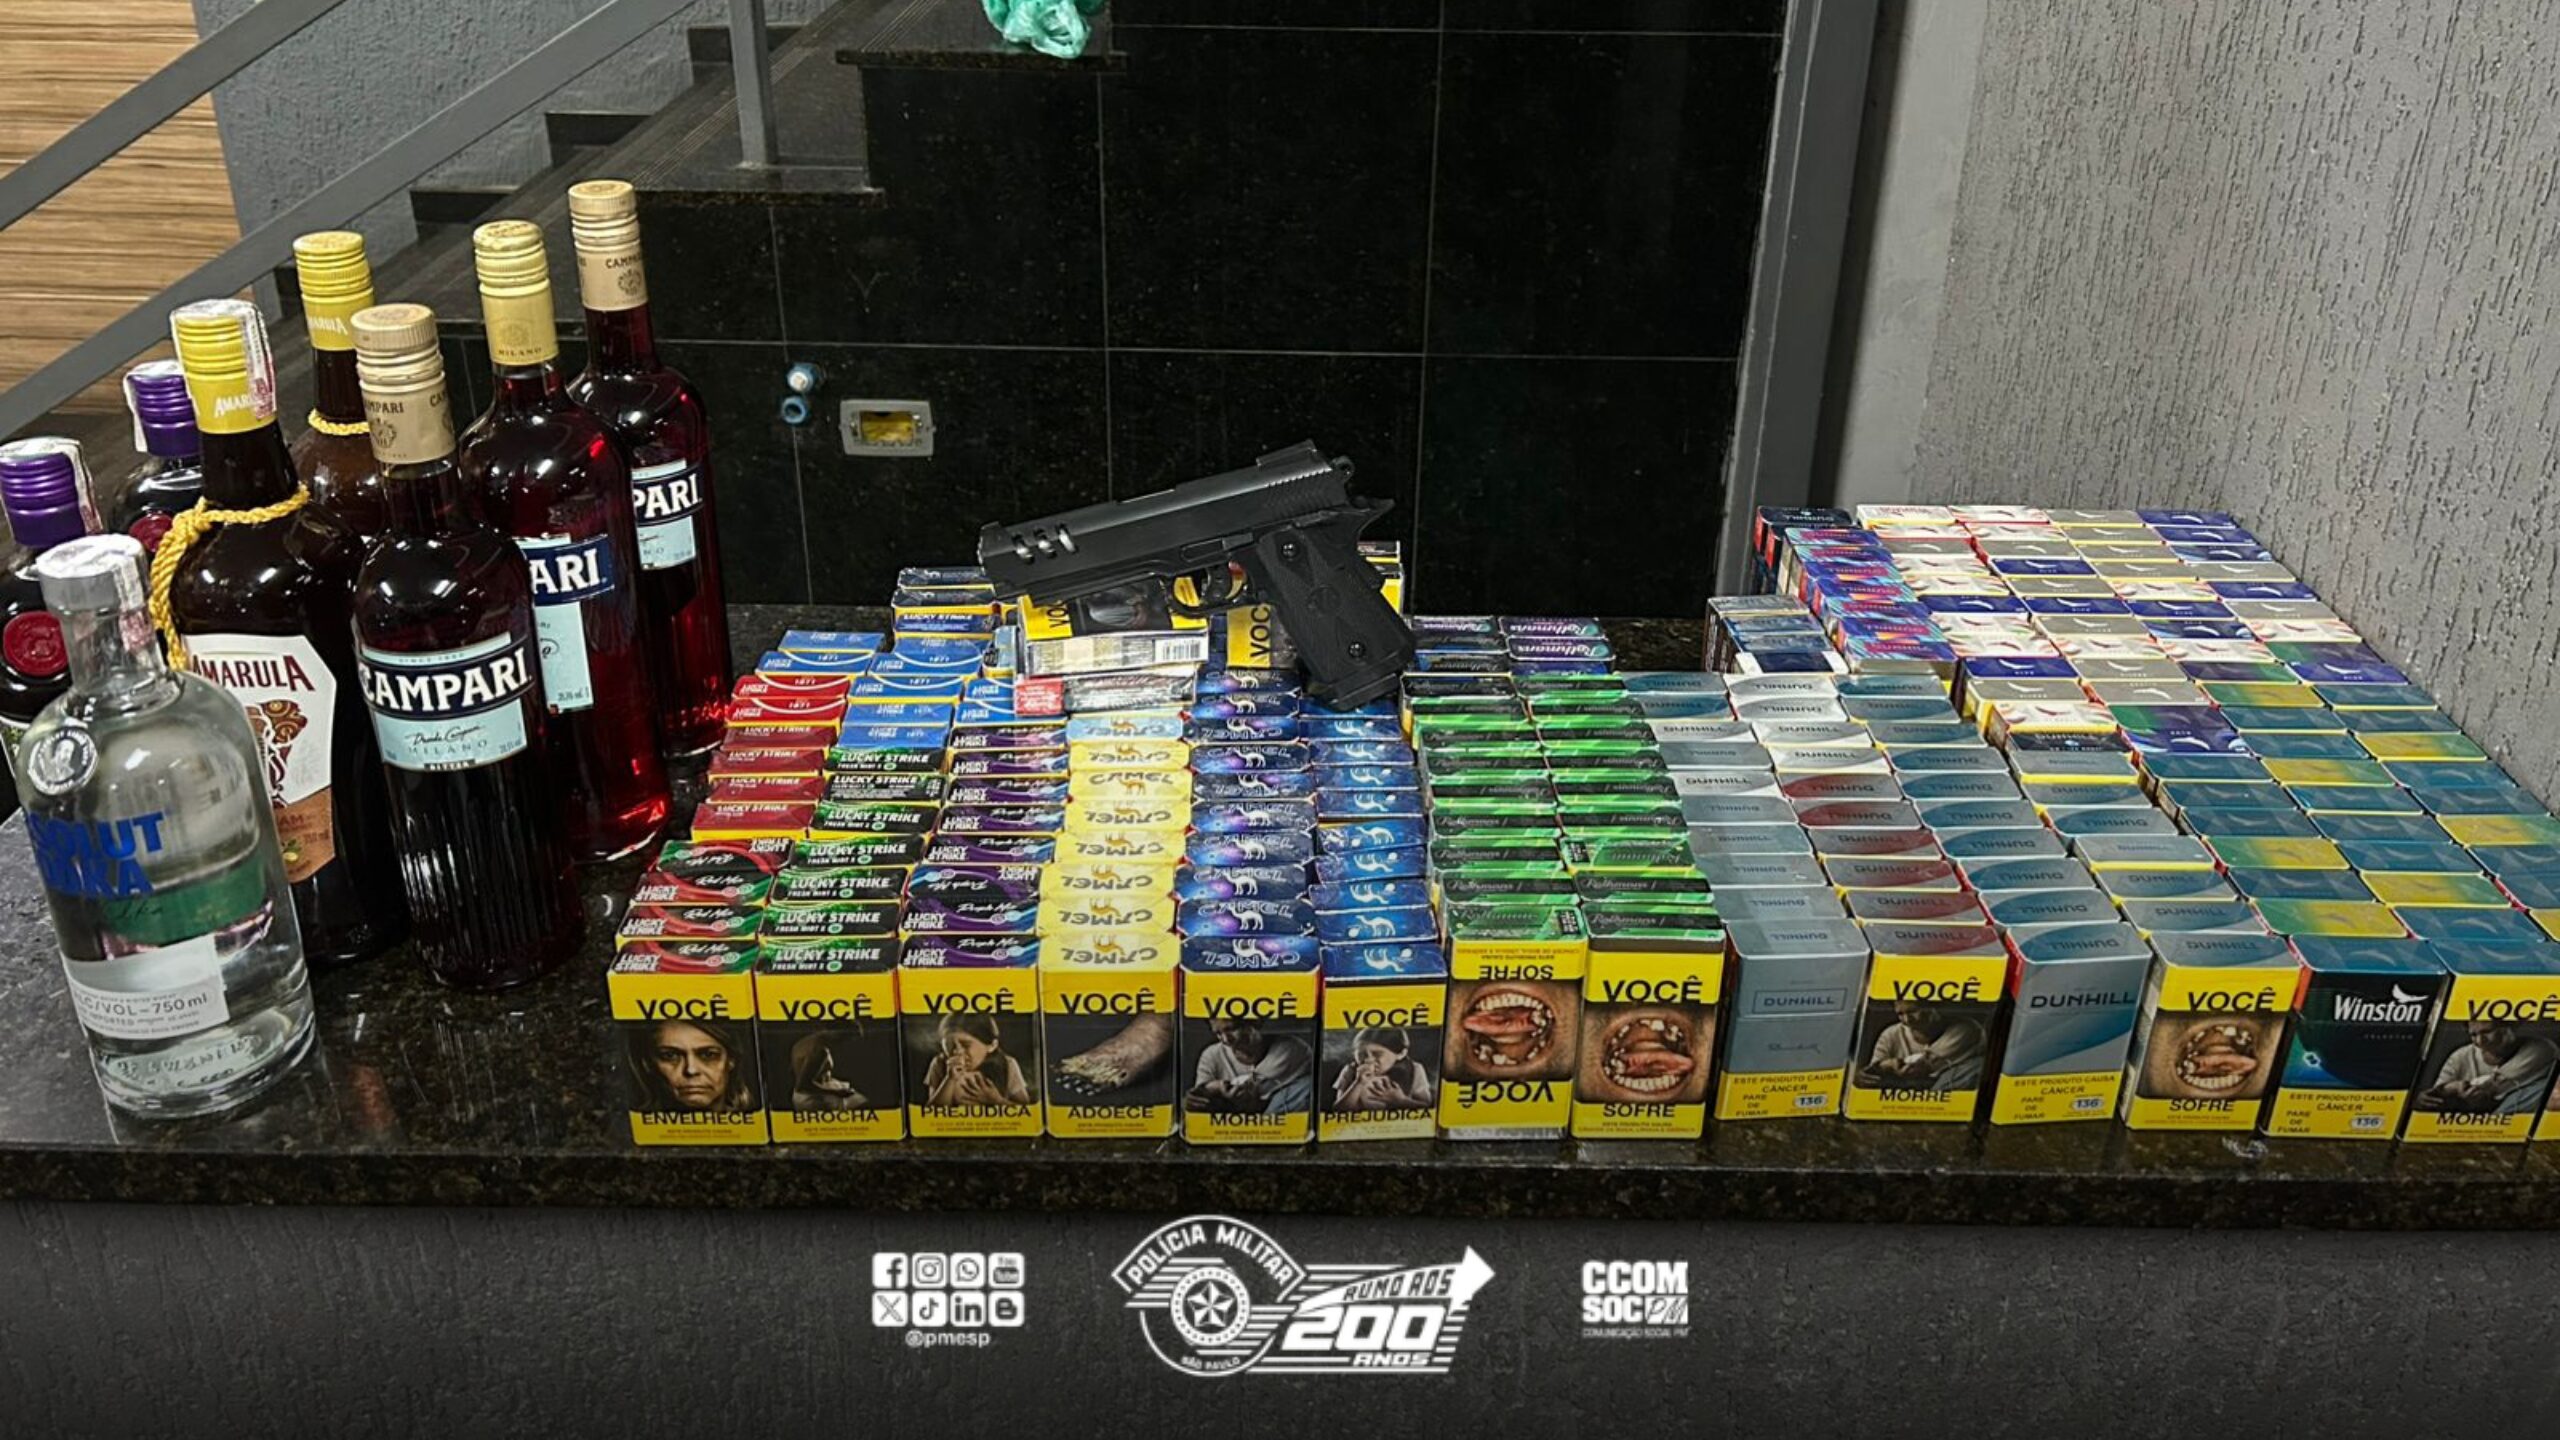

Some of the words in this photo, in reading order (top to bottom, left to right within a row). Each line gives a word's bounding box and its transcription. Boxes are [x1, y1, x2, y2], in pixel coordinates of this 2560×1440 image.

[1249, 601, 1271, 657] VOC
[192, 654, 316, 692] AMARULA
[358, 647, 532, 713] CAMPARI
[841, 752, 882, 762] LUCKY
[884, 753, 930, 764] STRIKE
[834, 775, 874, 783] LUCKY
[875, 775, 919, 784] STRIKE
[1089, 772, 1175, 785] CAMEL
[829, 810, 873, 821] LUCKY
[873, 813, 921, 823] STRIKE
[809, 846, 855, 857] LUCKY
[858, 843, 907, 854] STRIKE
[1075, 842, 1165, 856] CAMEL
[791, 877, 838, 889] LUCKY
[840, 877, 890, 888] STRIKE
[1060, 875, 1153, 890] CAMEL
[778, 911, 826, 924] LUCKY
[828, 912, 881, 923] STRIKE
[904, 920, 945, 929] STRIKE
[907, 912, 947, 922] LUCKY
[1057, 909, 1154, 926] CAMEL
[775, 948, 824, 961] LUCKY
[826, 948, 881, 960] STRIKE
[903, 957, 946, 966] STRIKE
[907, 949, 948, 958] LUCKY
[1060, 947, 1159, 964] CAMEL
[1478, 964, 1554, 981] SOFRE
[1602, 975, 1704, 1002] VOCÊ
[1892, 976, 1982, 1002] VOCÊ
[635, 993, 731, 1021] VOCÊ
[779, 993, 874, 1021] VOCÊ
[923, 987, 1016, 1015] VOCÊ
[1059, 987, 1157, 1015] VOCÊ
[1202, 991, 1298, 1019] VOCÊ
[1763, 994, 1836, 1008] DUNHILL
[2029, 992, 2138, 1009] DUNHILL
[2187, 987, 2278, 1013] VOCÊ
[2468, 994, 2560, 1021] VOCÊ
[1342, 1002, 1430, 1028] VOCÊ
[2333, 994, 2422, 1023] Winston
[1457, 1081, 1556, 1110] VOCÊ
[1762, 1084, 1809, 1094] CÂNCER
[1879, 1088, 1952, 1103] MORRE
[1798, 1095, 1823, 1105] 136
[2076, 1098, 2099, 1109] 136
[2168, 1099, 2236, 1113] SOFRE
[2316, 1101, 2364, 1112] CÂNCER
[641, 1110, 755, 1127] ENVELHECE
[793, 1109, 880, 1125] BROCHA
[920, 1103, 1032, 1119] PREJUDICA
[1067, 1105, 1155, 1120] ADOECE
[1323, 1108, 1433, 1125] PREJUDICA
[1602, 1102, 1676, 1119] SOFRE
[1209, 1111, 1287, 1128] MORRE
[2355, 1117, 2380, 1127] 136
[2435, 1111, 2513, 1127] MORRE
